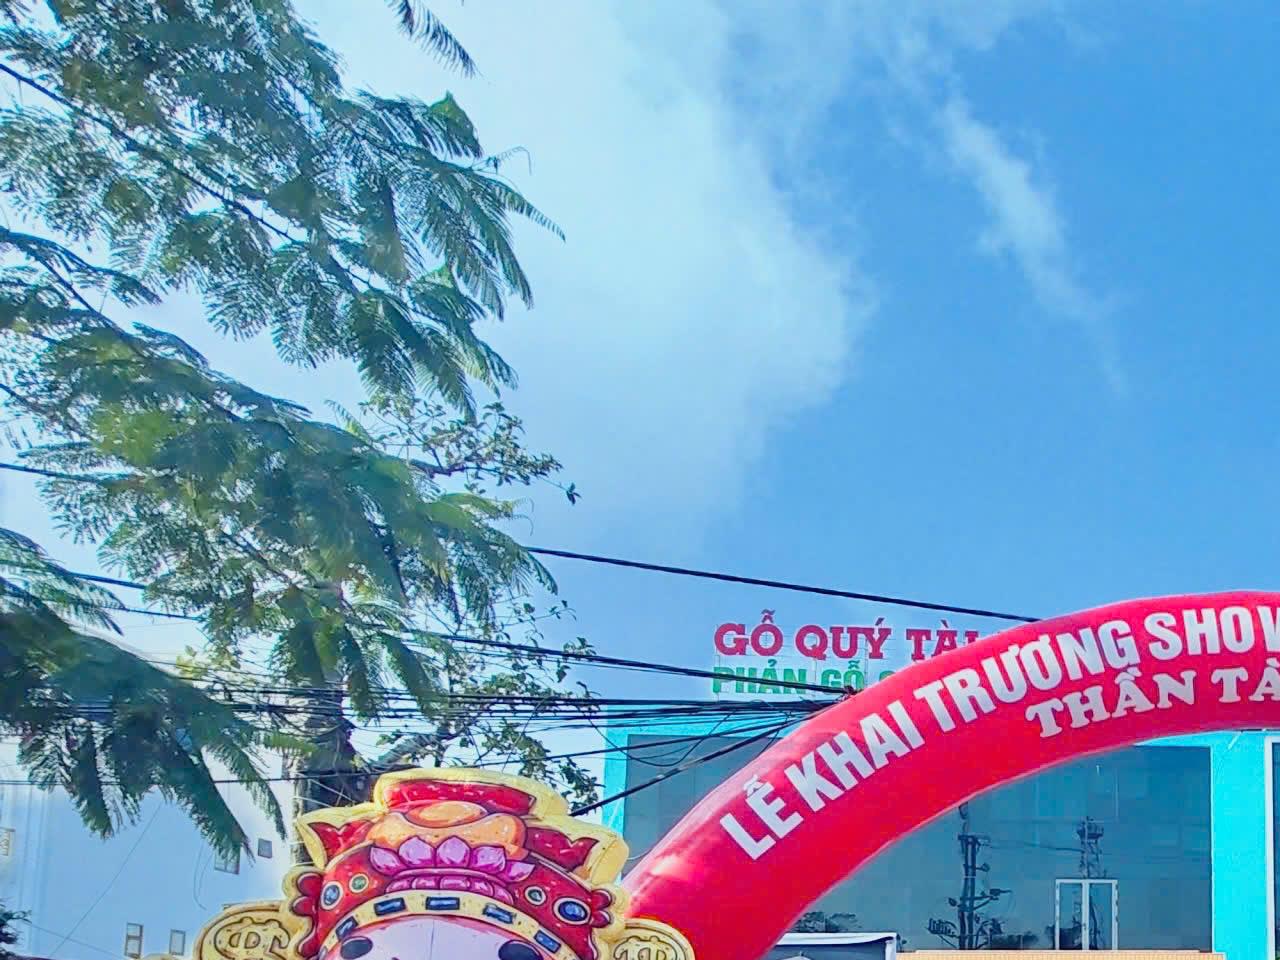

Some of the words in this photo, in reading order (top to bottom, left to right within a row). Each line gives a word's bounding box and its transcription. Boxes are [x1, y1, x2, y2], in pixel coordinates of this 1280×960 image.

[714, 609, 783, 656] GỖ
[795, 617, 892, 661] QUÝ
[712, 659, 807, 694] PHẢN
[821, 660, 865, 692] GỖ
[1025, 667, 1197, 738] THẦN
[720, 775, 803, 861] LỄ
[784, 702, 925, 813] KHAI
[913, 616, 1138, 734] TRƯƠNG
